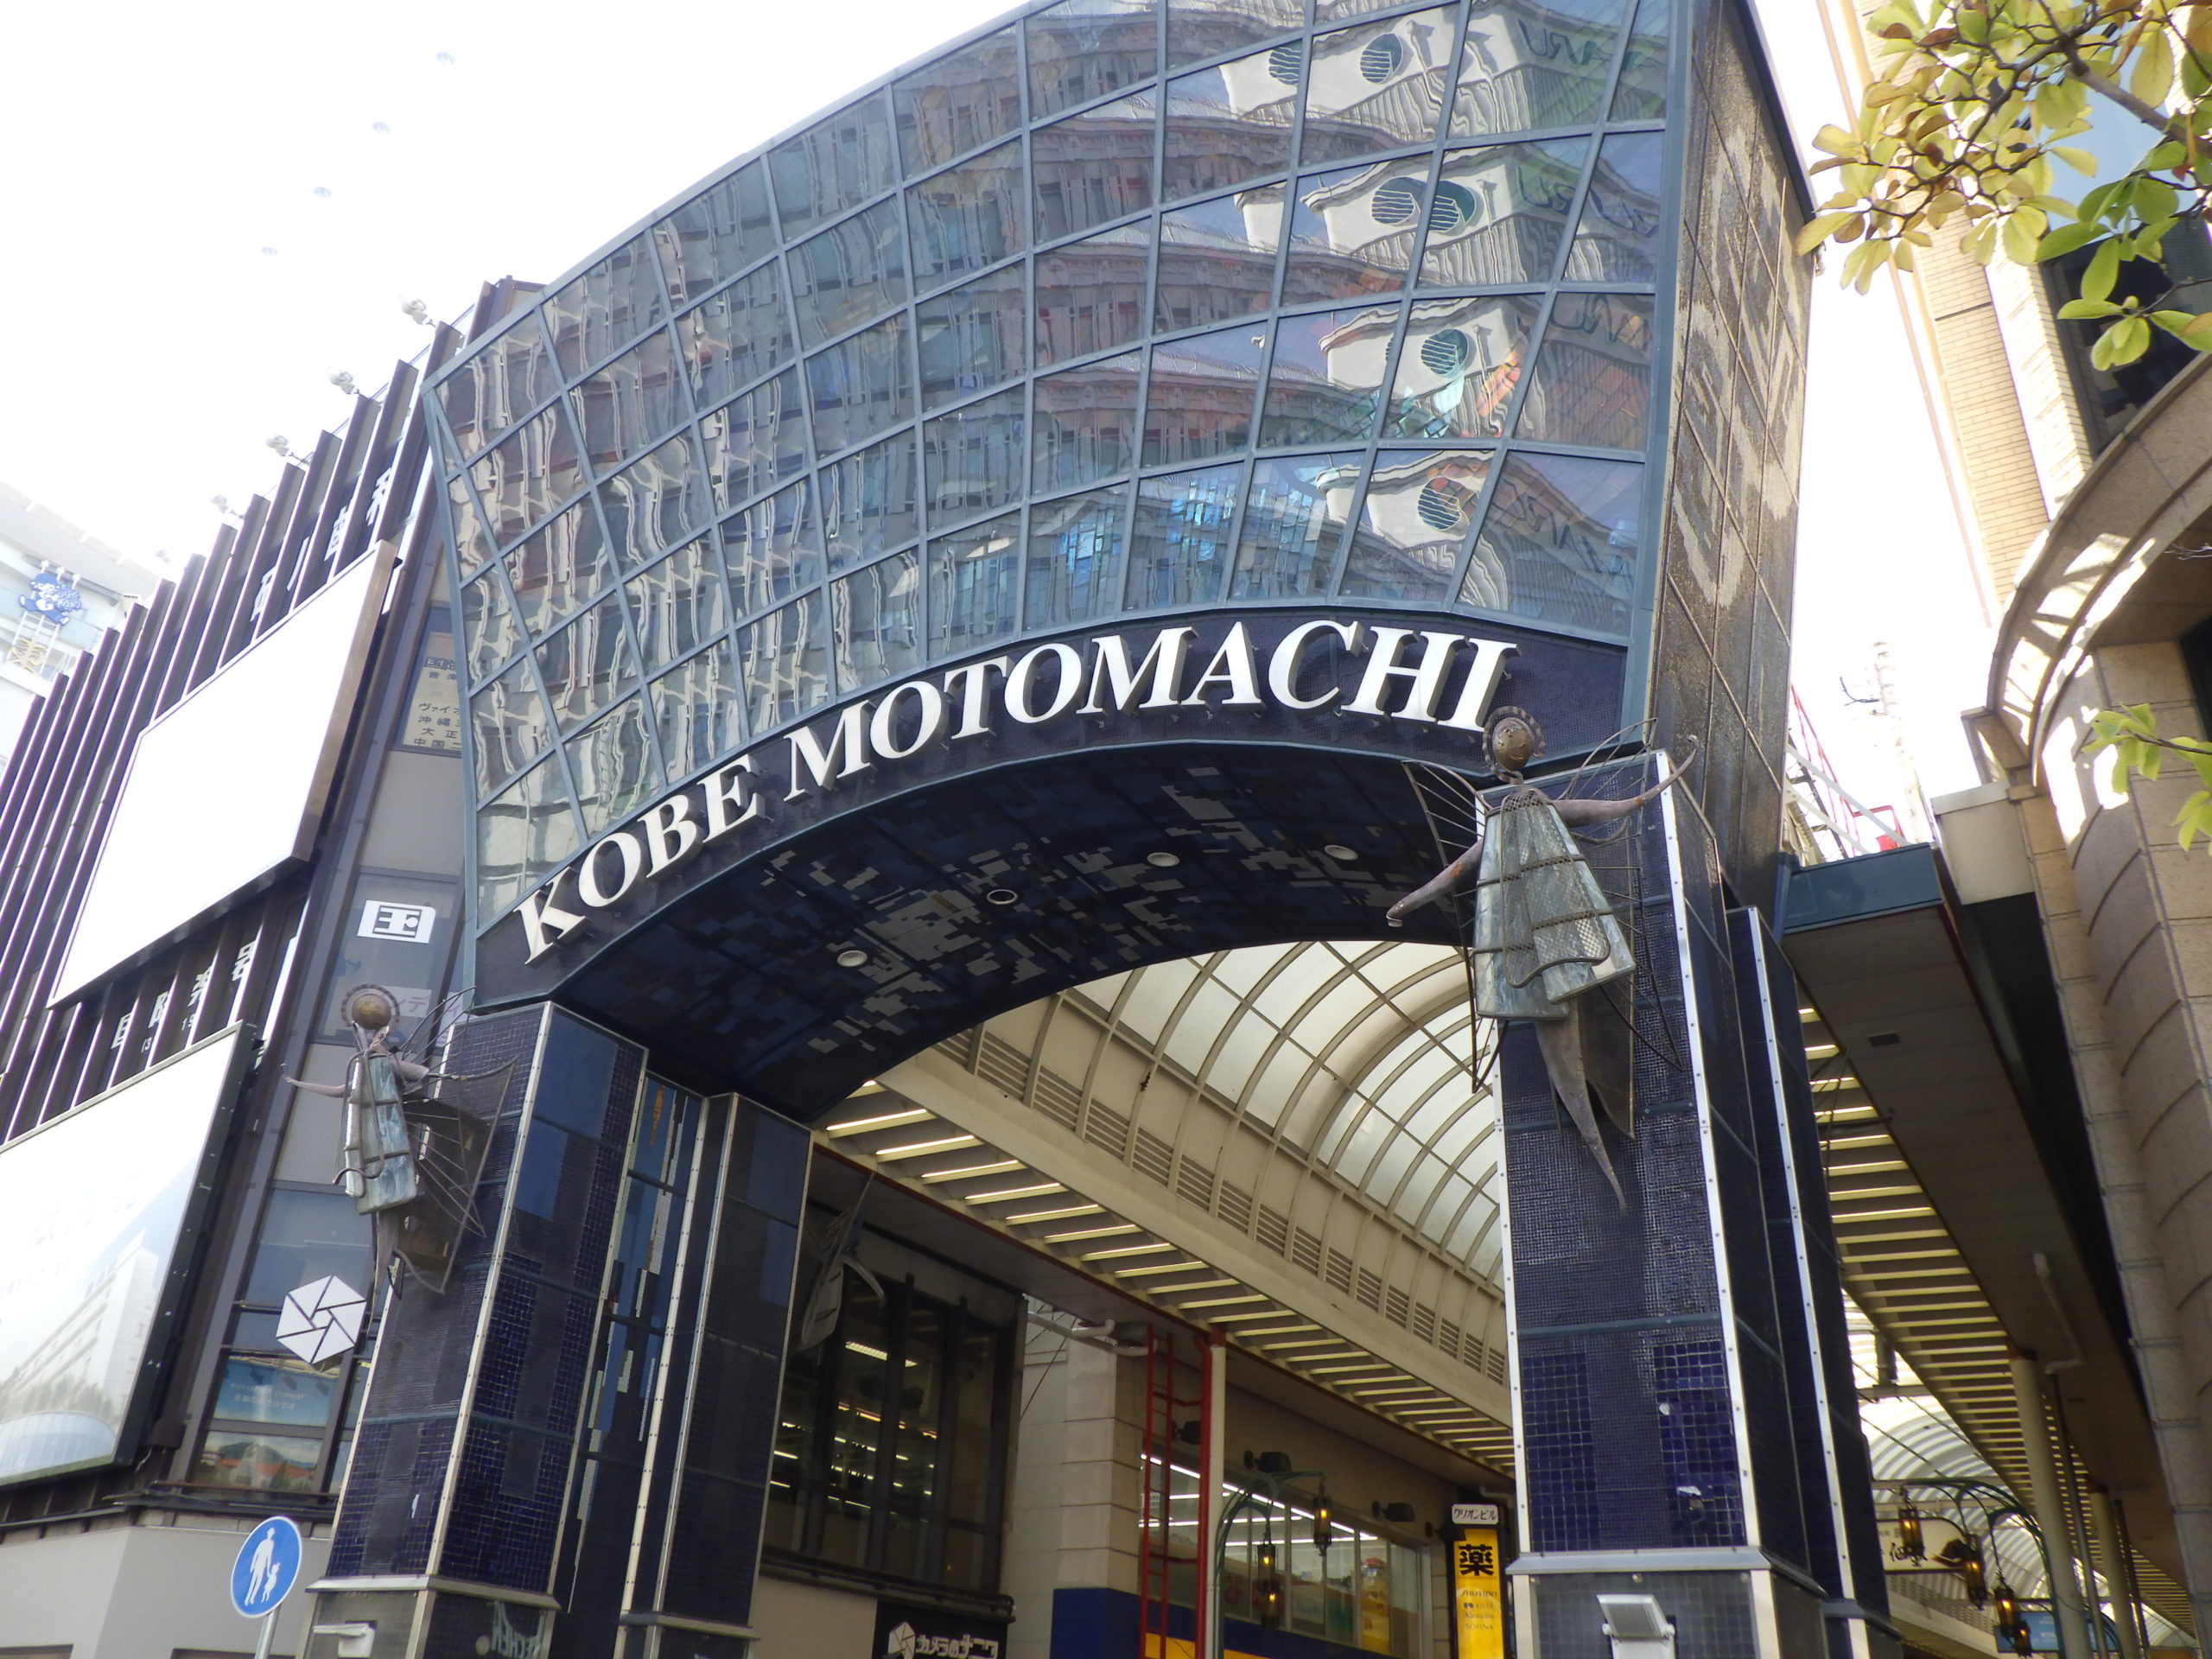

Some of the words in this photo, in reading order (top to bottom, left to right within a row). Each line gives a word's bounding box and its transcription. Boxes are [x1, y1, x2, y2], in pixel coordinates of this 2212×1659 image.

[514, 754, 767, 963] KOBE
[783, 620, 1521, 801] MOTOMACHI
[1458, 1543, 1495, 1577] 薬
[915, 1634, 1000, 1659] カメラのナニワ
